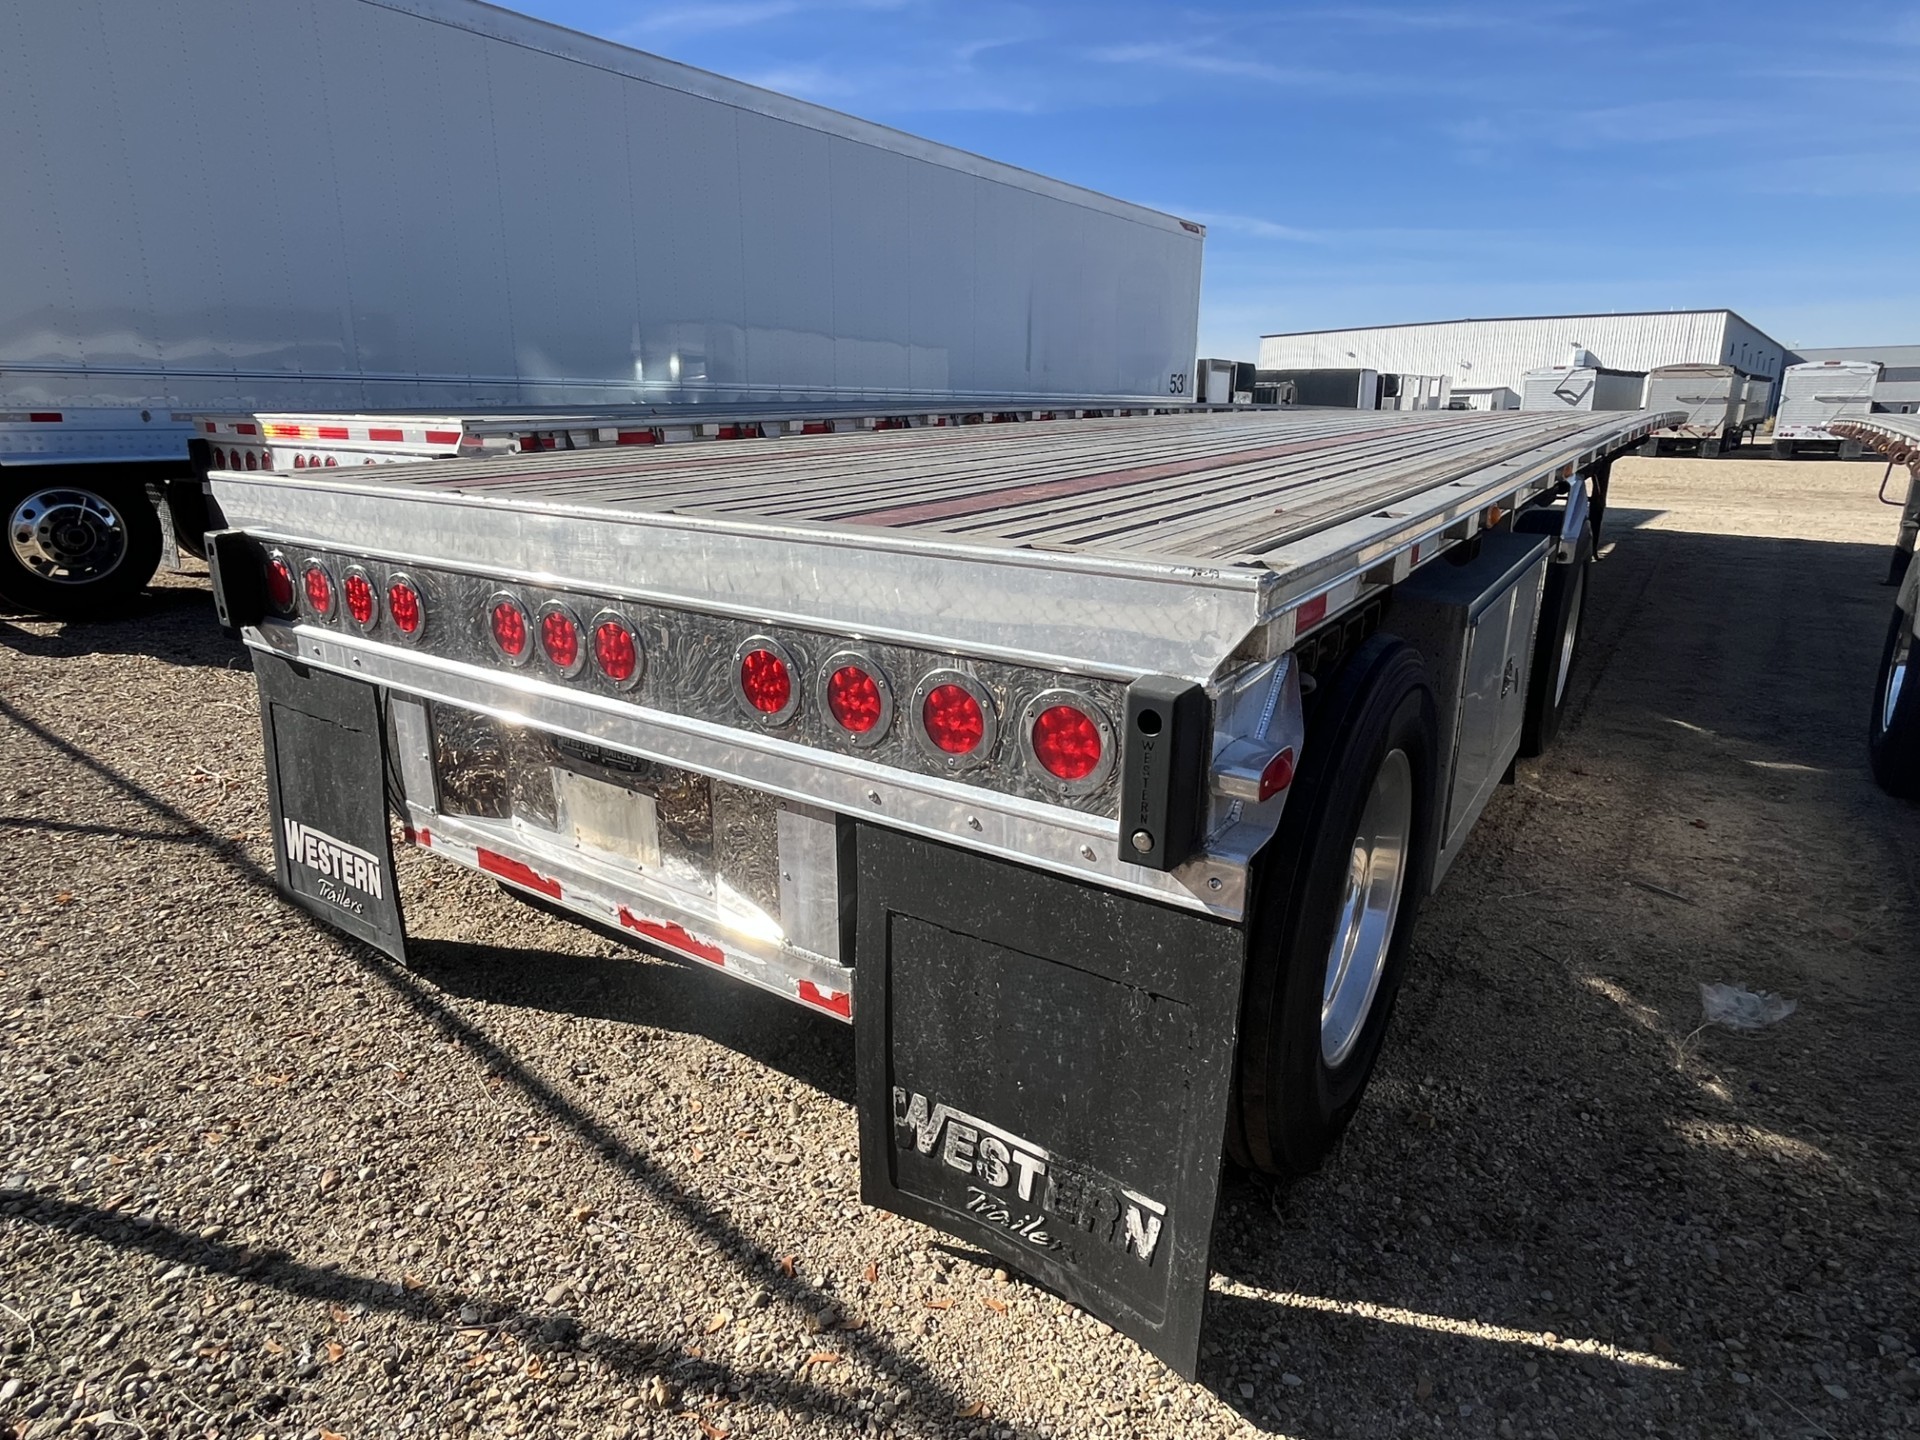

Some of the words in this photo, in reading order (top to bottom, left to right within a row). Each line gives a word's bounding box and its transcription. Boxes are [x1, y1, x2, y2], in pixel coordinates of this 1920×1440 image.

[1140, 740, 1155, 825] WESTERN
[284, 817, 382, 900] WESTERN
[317, 878, 363, 914] Trailers
